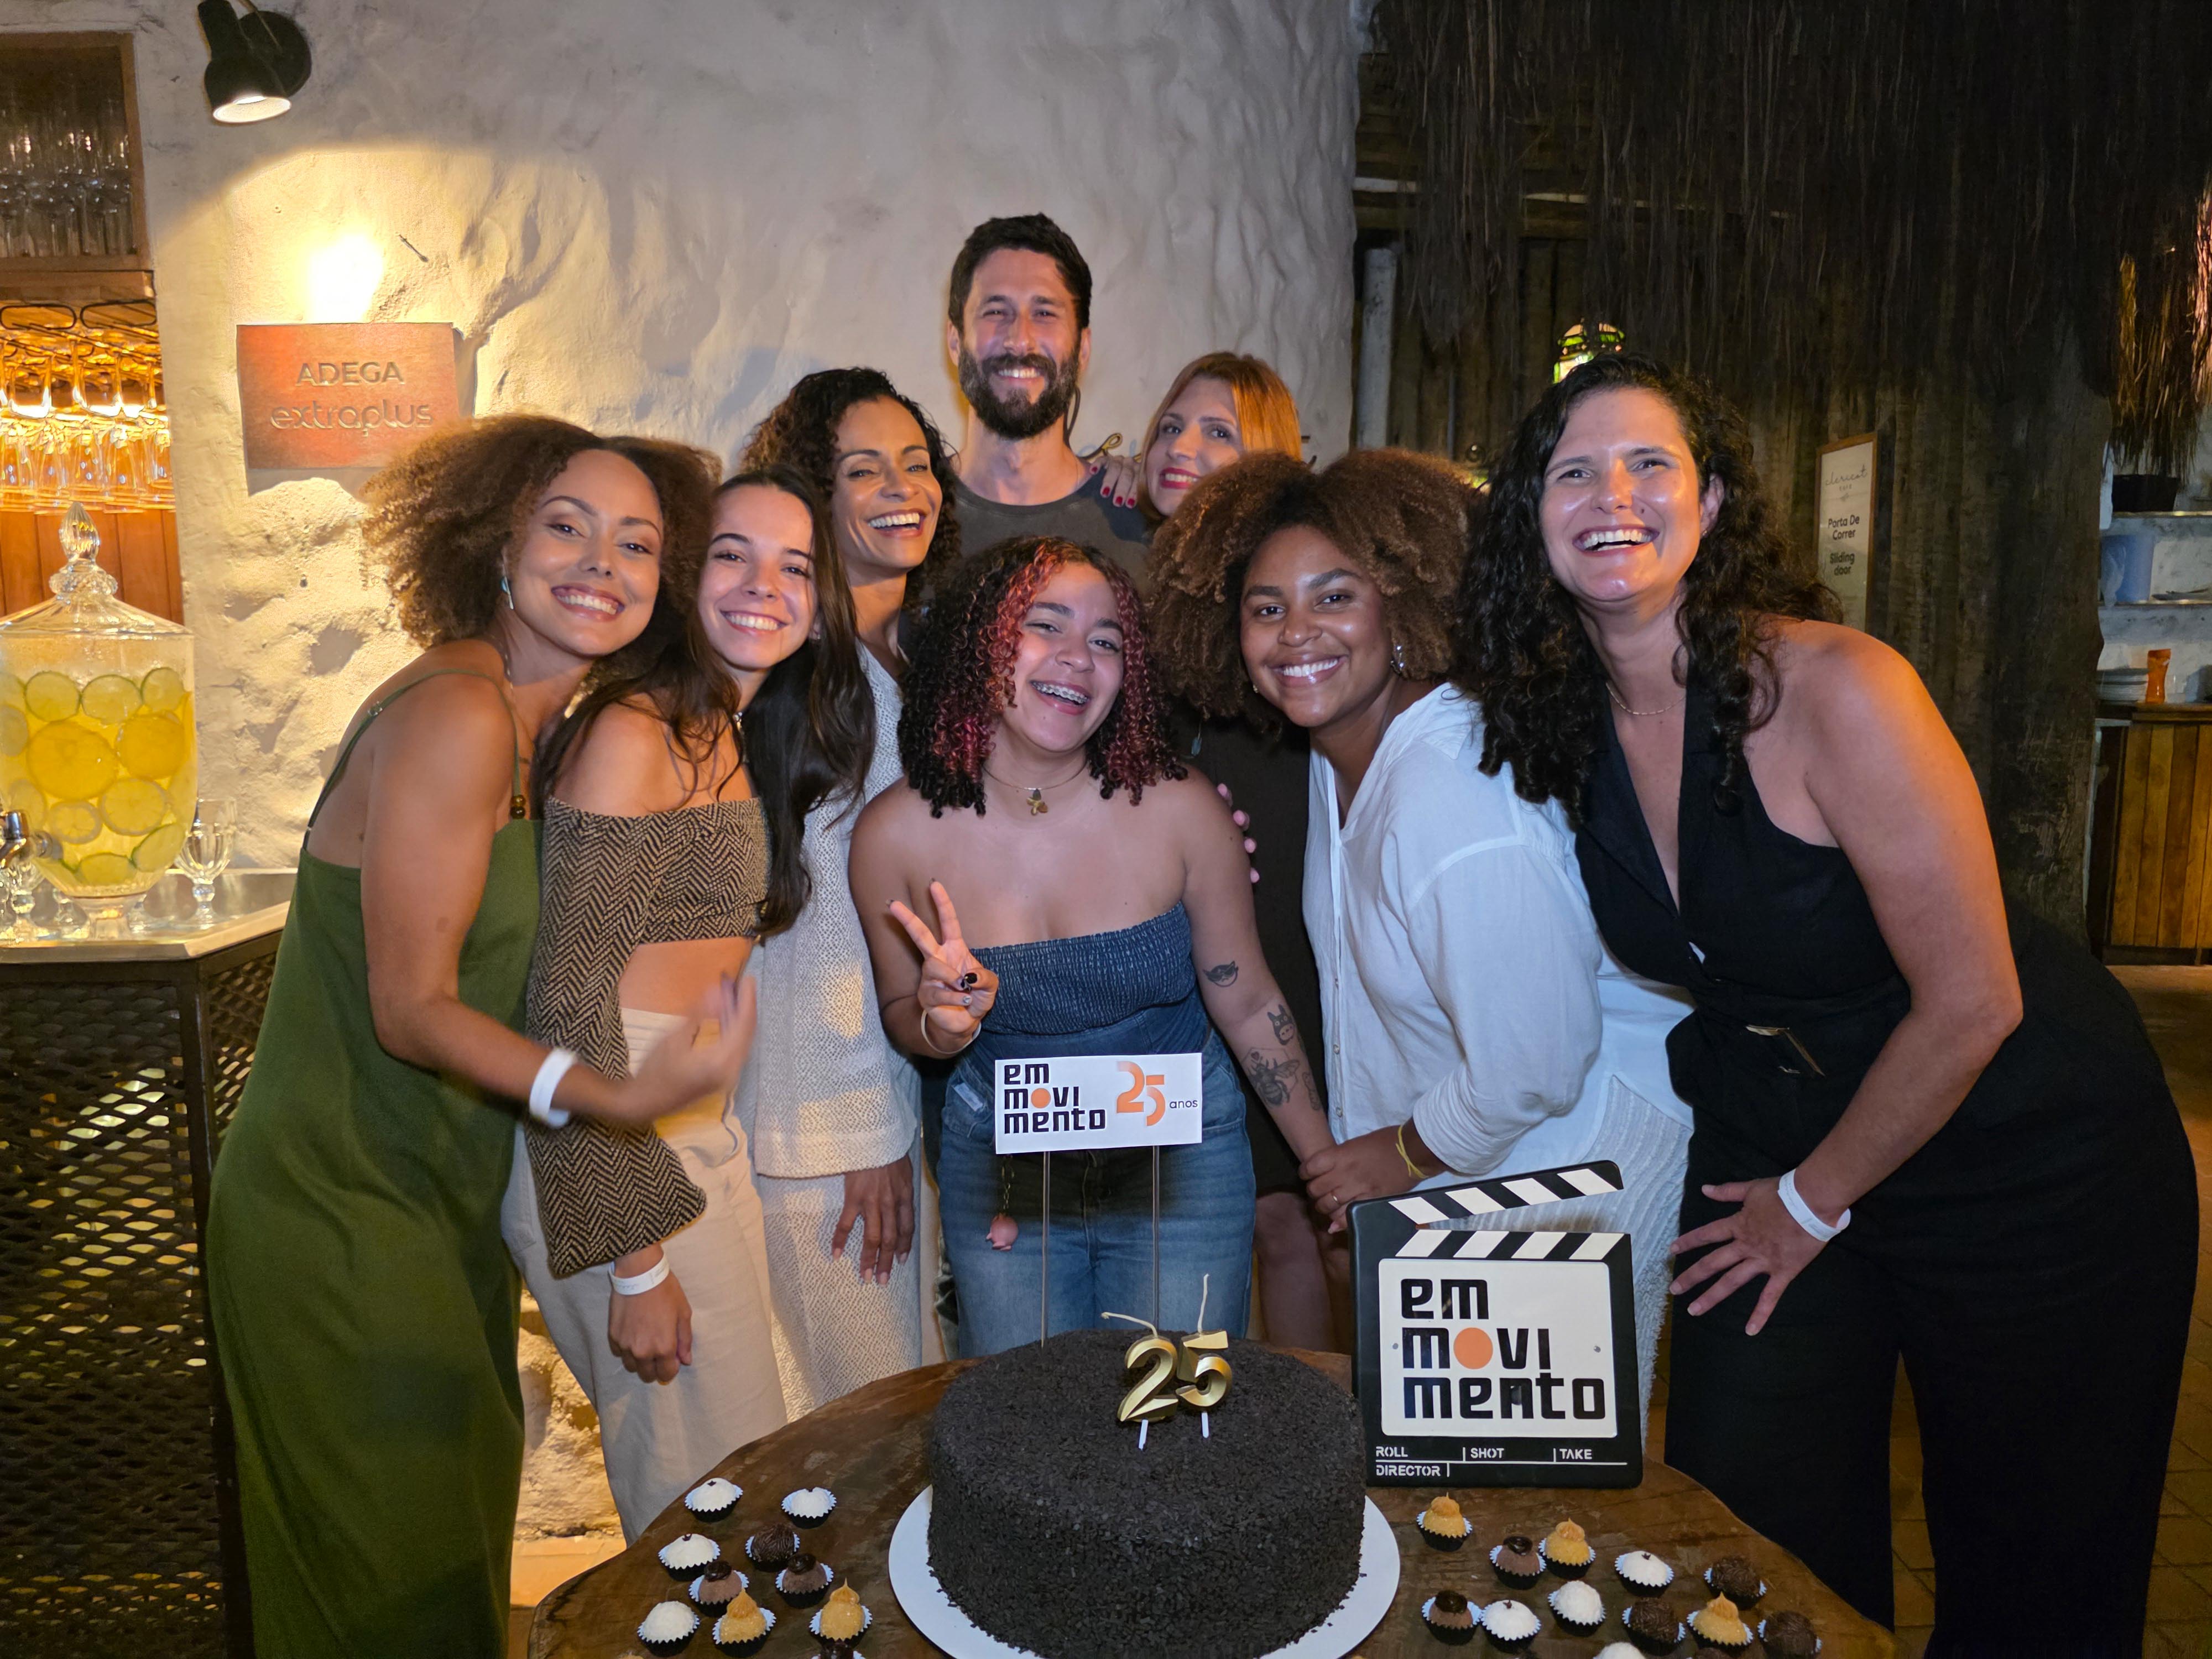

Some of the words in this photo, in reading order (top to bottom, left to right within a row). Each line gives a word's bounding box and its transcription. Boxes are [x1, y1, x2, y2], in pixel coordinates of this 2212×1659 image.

[296, 362, 405, 386] ADEGA
[270, 399, 434, 437] extraplus
[1828, 518, 1848, 528] Porta
[1850, 514, 1860, 525] De
[1832, 529, 1856, 540] Correr
[1830, 551, 1855, 565] Sliding
[1834, 565, 1851, 576] door
[1004, 1063, 1049, 1084] em
[1116, 1061, 1166, 1126] 25
[1169, 1099, 1198, 1109] anos
[1004, 1108, 1106, 1134] mento
[1401, 1279, 1489, 1319] em
[1117, 1329, 1232, 1422] 25
[1403, 1373, 1606, 1420] mento
[1375, 1446, 1408, 1458] ROLL
[1470, 1448, 1505, 1459] SHOT
[1559, 1449, 1593, 1460] TAKE
[1375, 1465, 1441, 1477] DIRECTOR
